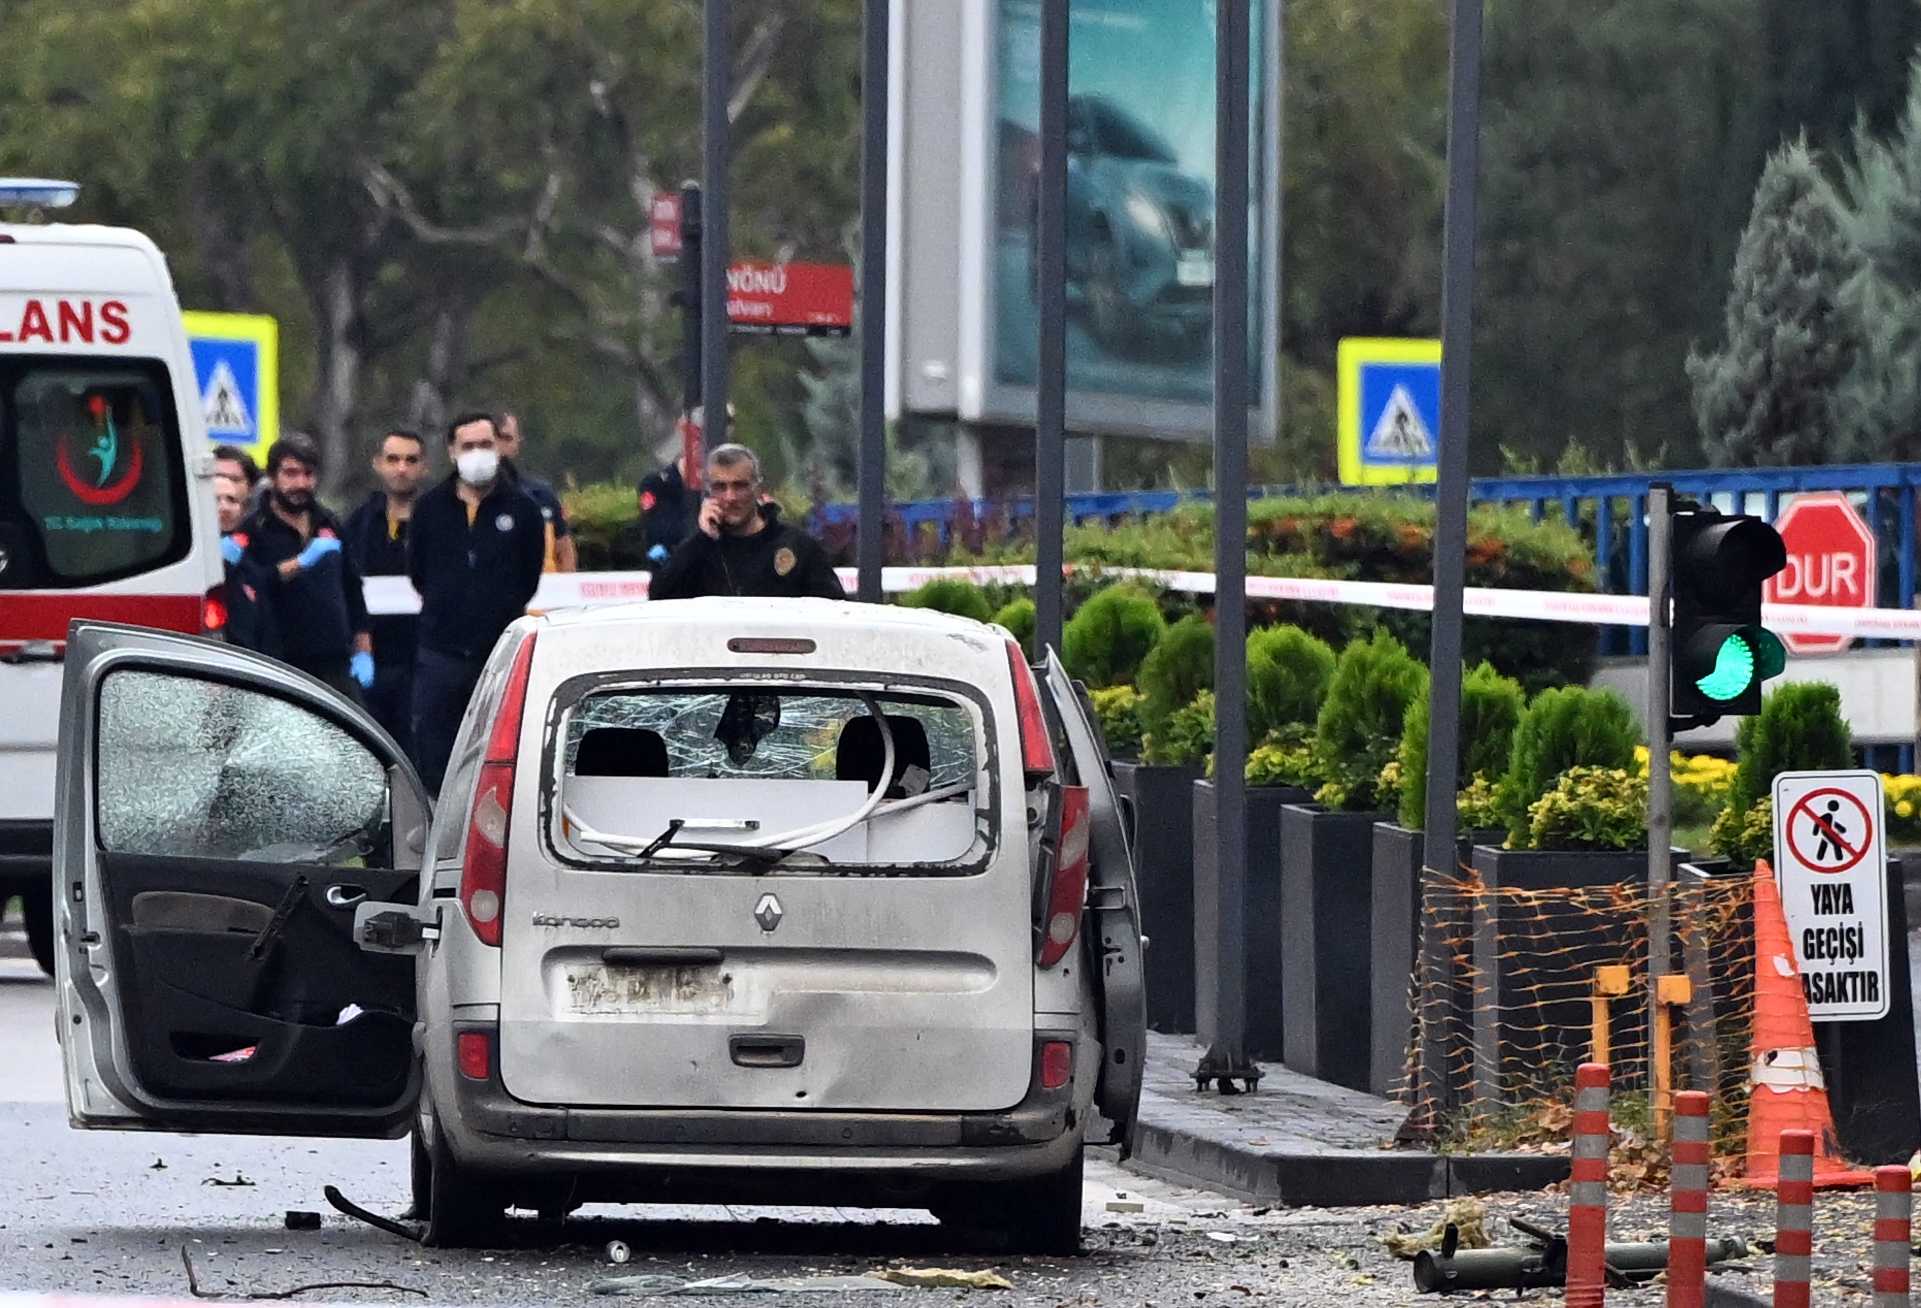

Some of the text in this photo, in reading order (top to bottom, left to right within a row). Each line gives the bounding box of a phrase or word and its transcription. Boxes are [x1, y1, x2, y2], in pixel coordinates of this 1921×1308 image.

[726, 265, 786, 294] NÖNÜ
[1775, 552, 1858, 599] DUR
[1810, 882, 1854, 916] YAYA
[1802, 920, 1865, 966] GEÇİŞİ
[1800, 970, 1879, 1005] ASAKTIR
